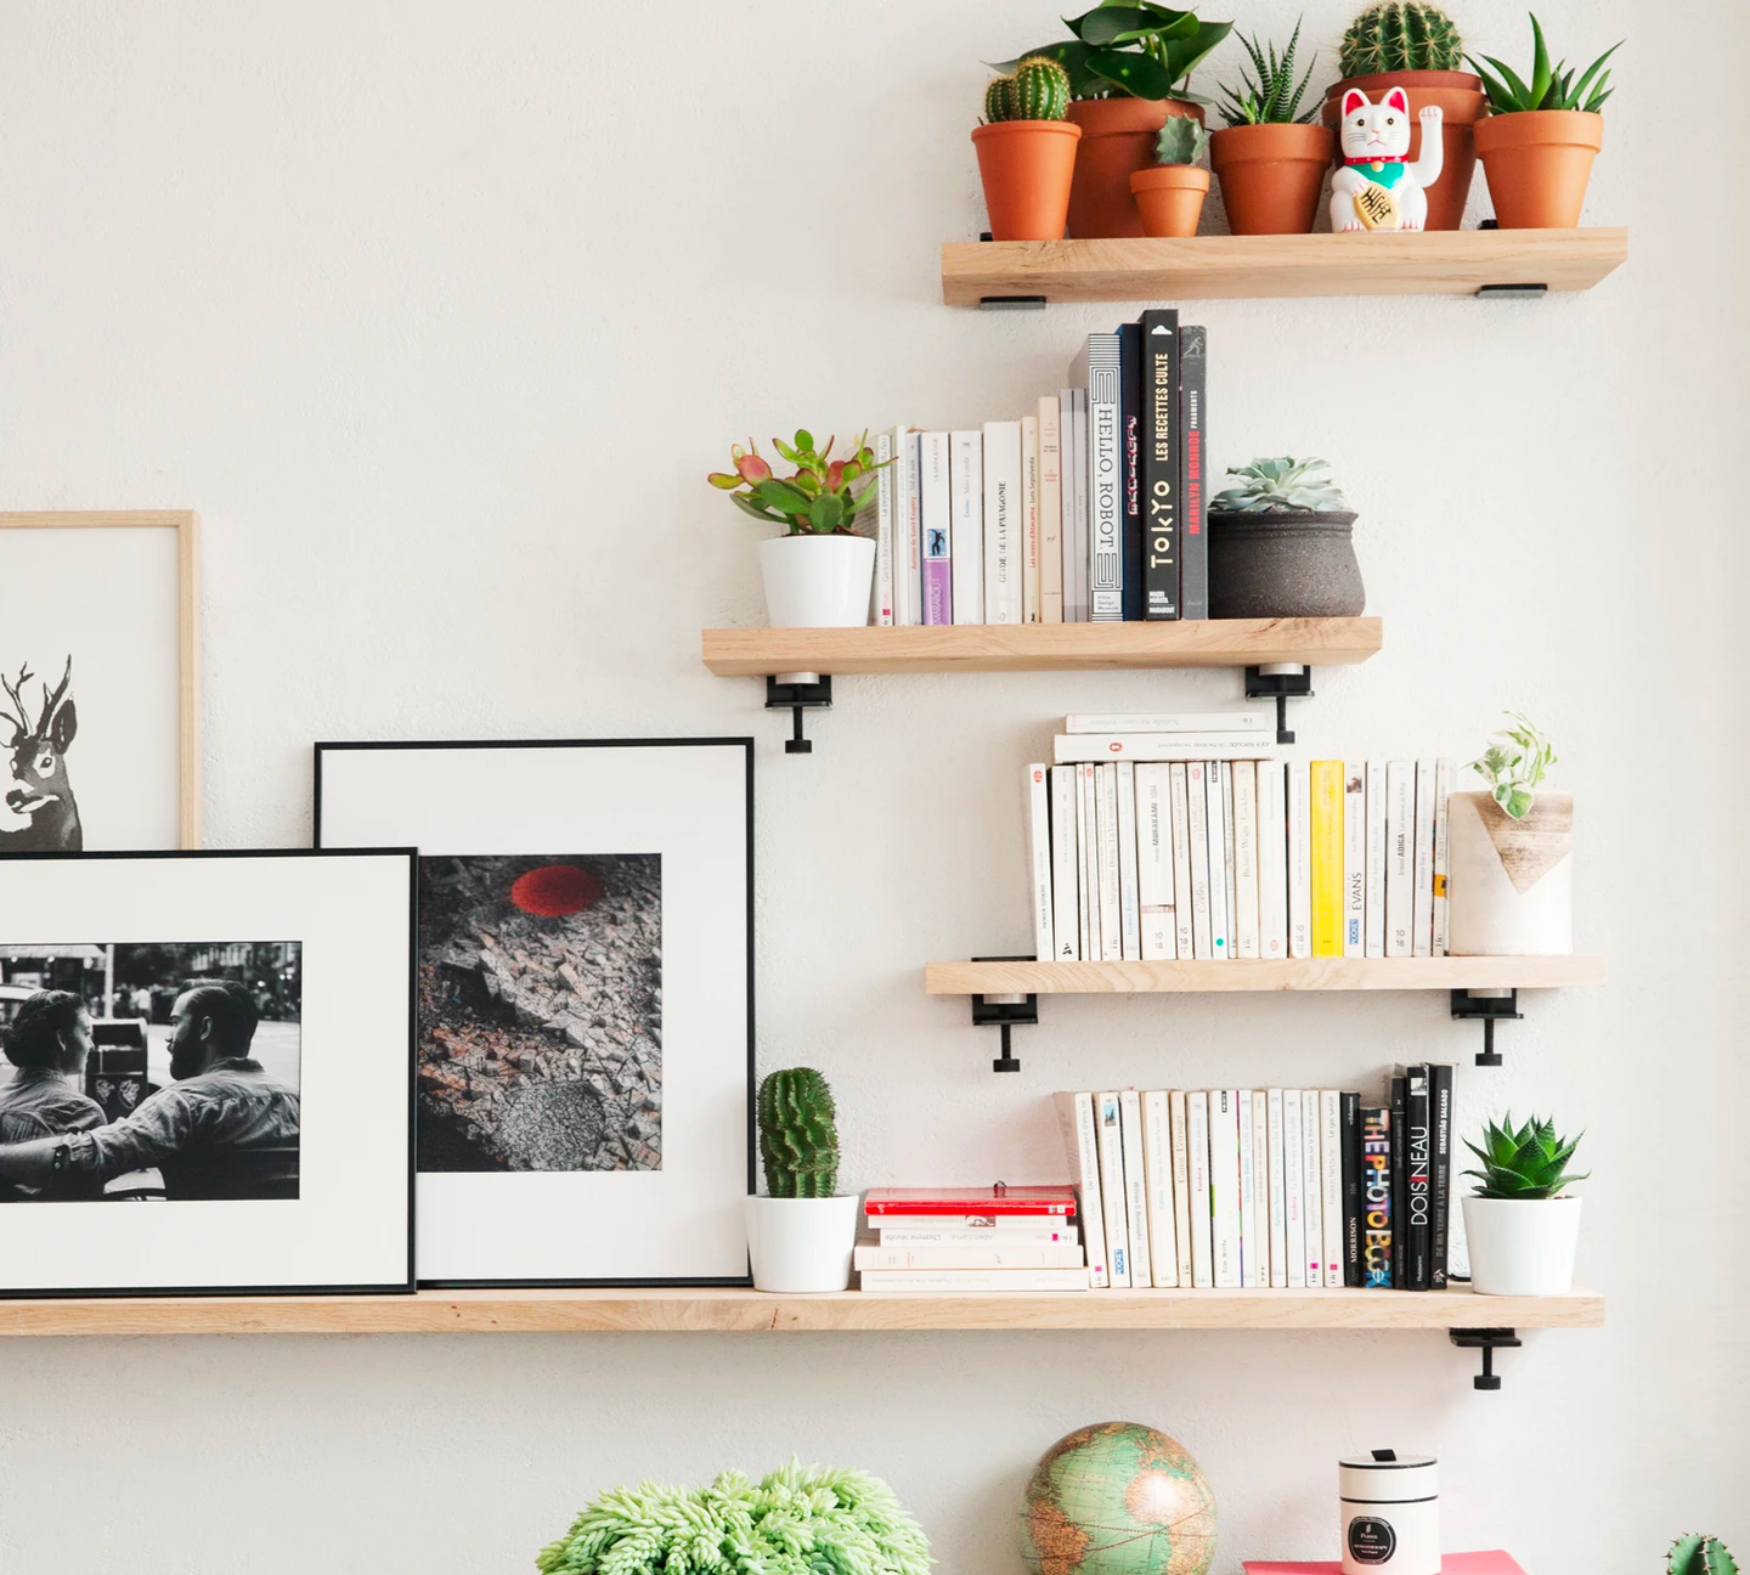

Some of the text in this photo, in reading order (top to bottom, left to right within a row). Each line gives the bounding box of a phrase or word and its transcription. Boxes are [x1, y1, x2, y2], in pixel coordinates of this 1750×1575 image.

[1154, 353, 1169, 462] LES RECETTES CULTE
[1189, 390, 1198, 429] FRAGMENTS
[1097, 408, 1115, 550] HELLO, ROBOT.
[1187, 430, 1201, 535] MARILYN MONROE
[1027, 490, 1036, 504] Luis
[997, 480, 1008, 583] GUIDE DE LA PATAGONIE
[1028, 541, 1037, 558] roses
[1028, 558, 1037, 569] Les
[1151, 803, 1160, 847] MURAKAMI
[1396, 833, 1406, 858] ADIGA
[1352, 872, 1362, 911] EVANS
[1440, 1089, 1449, 1119] SALGADO
[1438, 1164, 1447, 1188] TERRE
[1438, 1188, 1446, 1199] LA
[1436, 1208, 1445, 1232] TERRE
[1349, 1217, 1358, 1264] MORRISON
[1436, 1233, 1444, 1246] MA
[1436, 1246, 1444, 1258] DE
